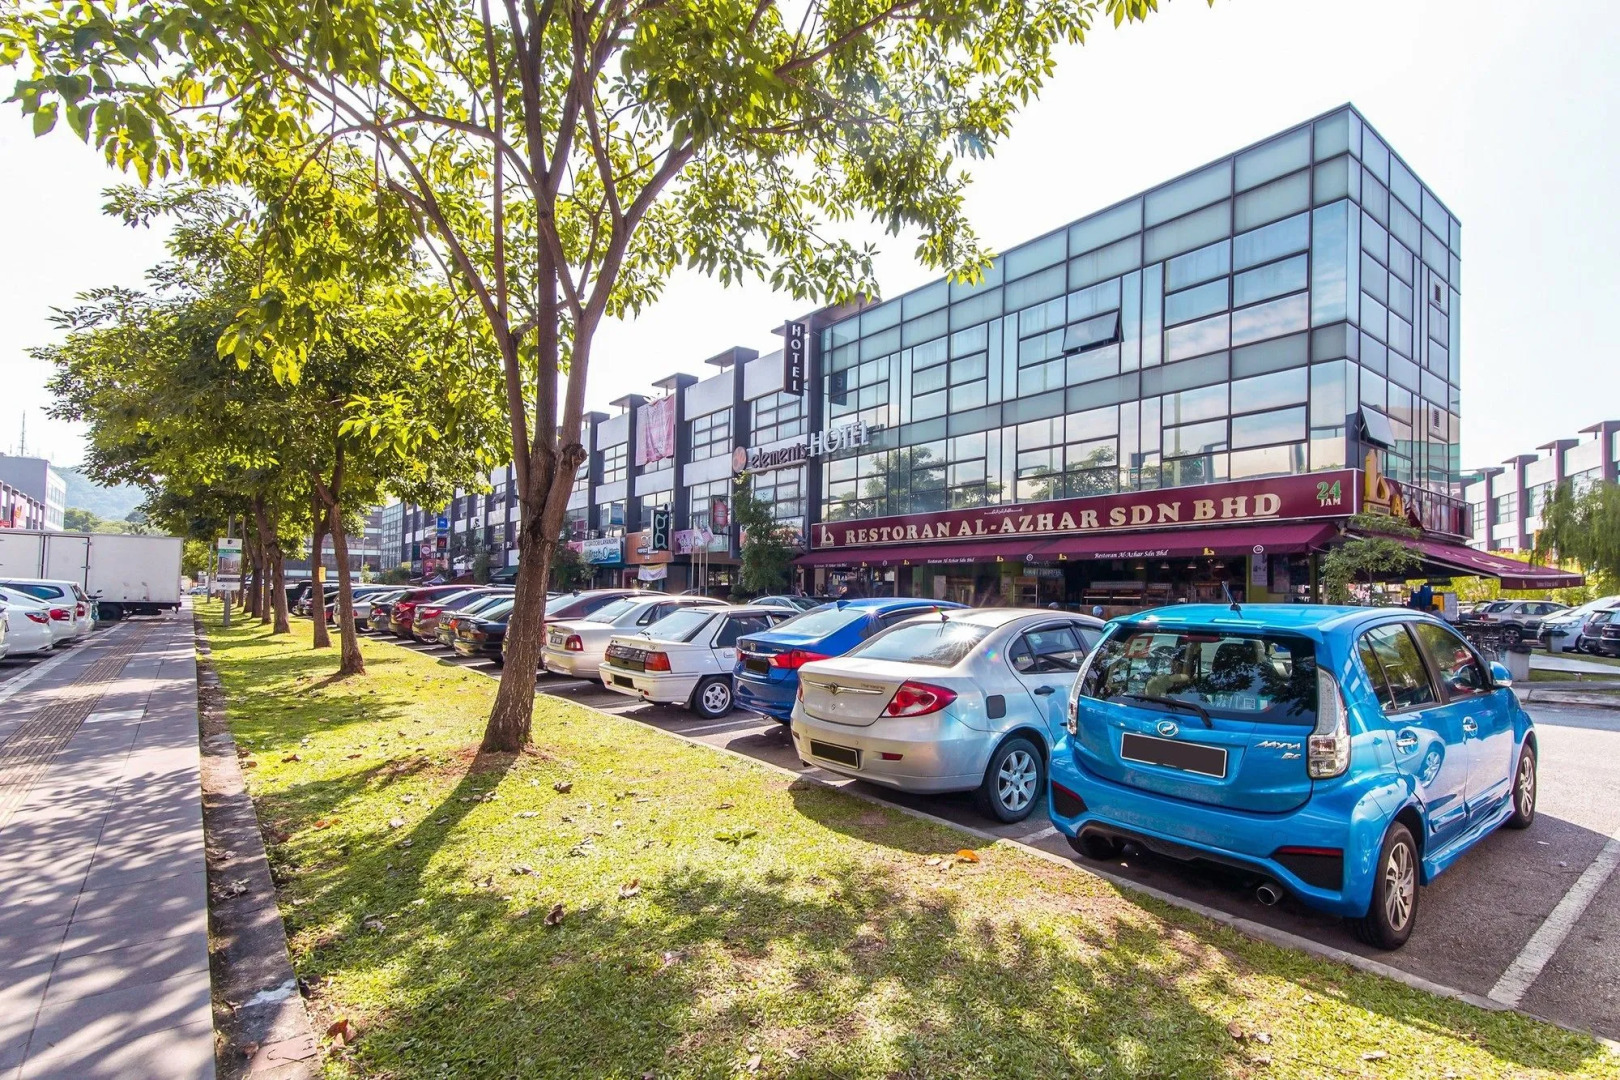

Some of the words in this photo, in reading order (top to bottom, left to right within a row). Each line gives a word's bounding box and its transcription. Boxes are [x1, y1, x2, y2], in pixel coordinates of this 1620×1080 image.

[790, 324, 801, 392] HOTEL
[751, 443, 807, 469] elements
[810, 420, 870, 457] HOTEL
[1316, 480, 1342, 499] 24
[1320, 497, 1341, 507] JAM
[845, 522, 951, 545] RESTORAN
[957, 509, 1099, 536] AL-AZHAR
[1109, 502, 1181, 526] SDN
[1192, 493, 1281, 520] BHD
[1156, 549, 1169, 557] Bhd
[1127, 638, 1149, 656] P
